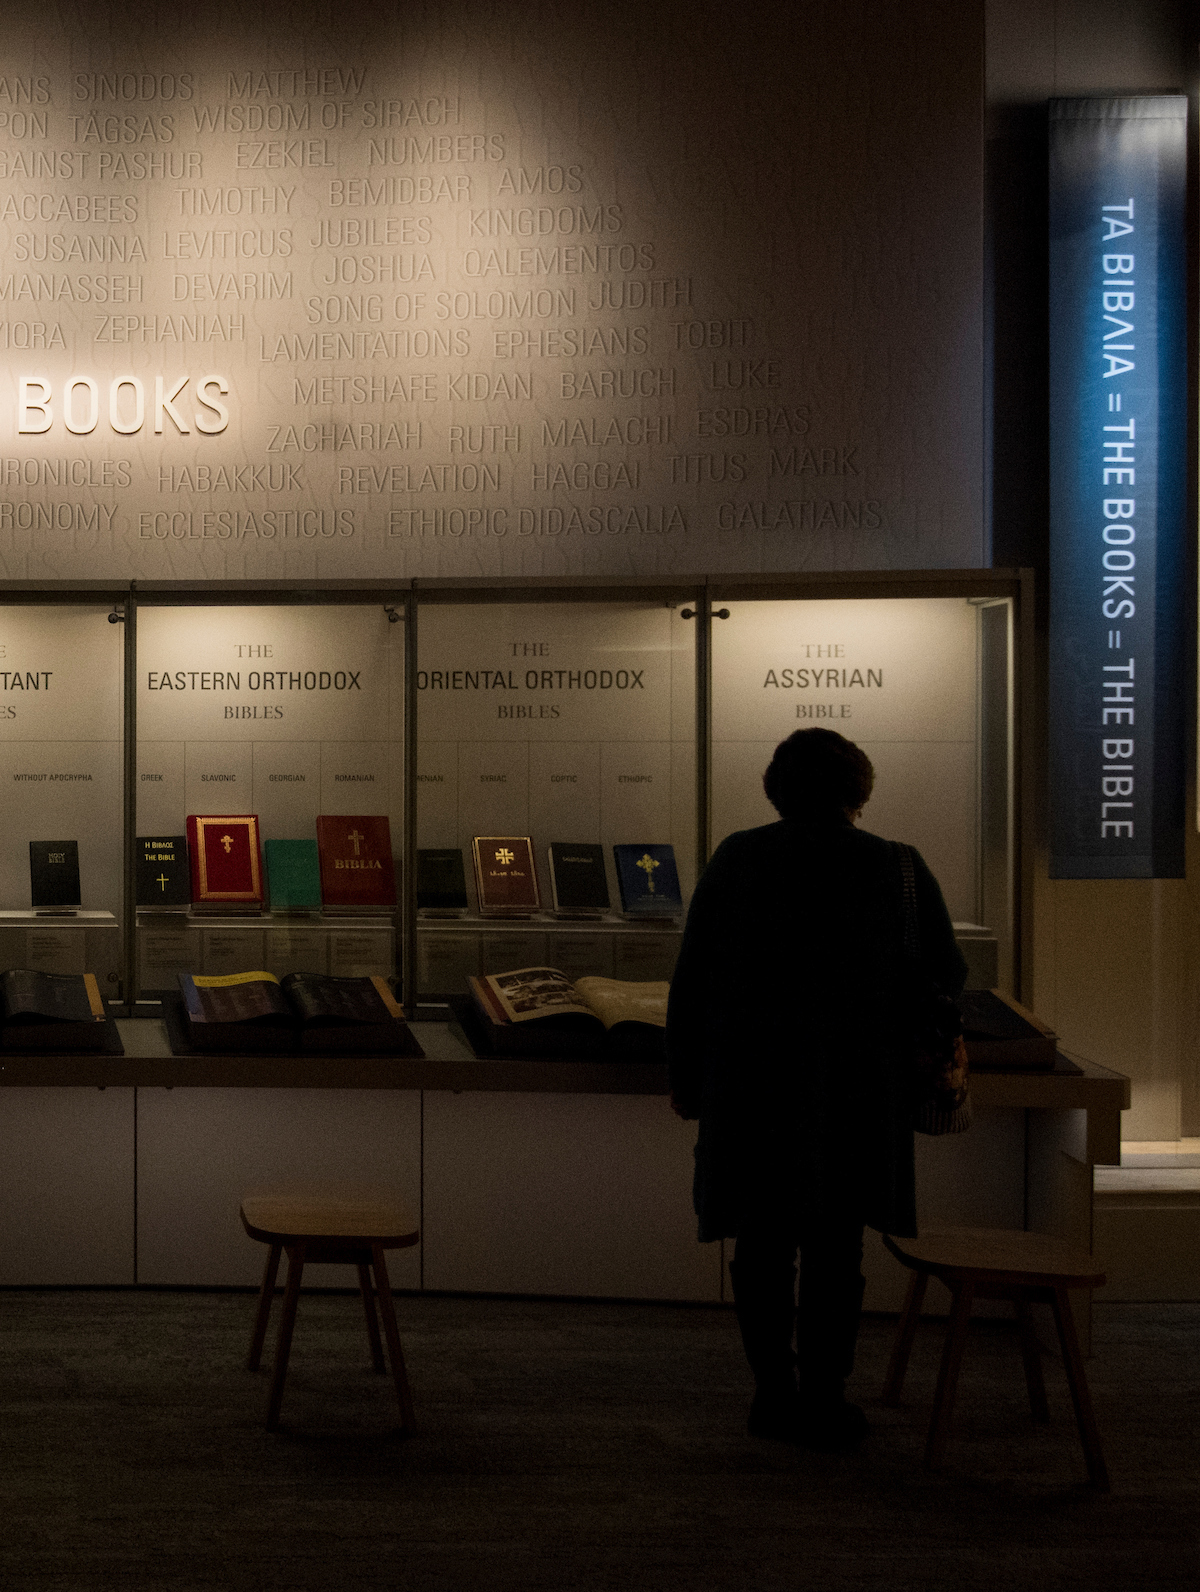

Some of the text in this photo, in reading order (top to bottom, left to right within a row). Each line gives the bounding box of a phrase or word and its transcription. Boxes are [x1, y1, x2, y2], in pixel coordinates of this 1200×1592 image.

[194, 98, 461, 135] WISDOM OF SIRACH
[236, 140, 334, 170] EZEKIEL
[368, 134, 506, 165] NUMBERS
[99, 152, 204, 180] PASHUR
[175, 186, 296, 216] TIMOTHY
[328, 176, 472, 207] BEMIDBAR
[13, 232, 147, 262] SUSANNA
[162, 229, 292, 260] LEVITICUS
[309, 217, 432, 249] JUBILEES
[323, 254, 436, 285] JOSHUA
[462, 243, 655, 278] QALEMENTOS
[172, 271, 292, 301] DEVARIM
[306, 290, 575, 323] SONG OF SOLOMON
[92, 314, 246, 343] ZEPHANIAH
[492, 328, 649, 359] EPHESIANS
[258, 331, 470, 363] LAMENTATIONS
[292, 371, 532, 406] METSHAFE KIDAN
[559, 368, 676, 399] BARUCH
[19, 373, 231, 438] BOOKS
[266, 422, 424, 454] ZACHARIAH
[449, 426, 521, 454] RUTH
[541, 416, 672, 448] MALACHI
[1101, 419, 1135, 486] THE
[158, 464, 304, 493] HABAKKUK
[339, 463, 501, 494] REVELATION
[531, 462, 641, 490] HAGGAI
[139, 509, 355, 540] ECCLESIASTICUS
[388, 506, 686, 538] ETHIOPIC DIDASCALIA
[1100, 499, 1135, 620] BOOKS
[234, 643, 273, 659] THE
[509, 642, 550, 657] THE
[801, 643, 845, 658] THE
[147, 671, 362, 691] EASTERN ORTHODOX
[417, 670, 645, 690] ORIENTAL ORTHODOX
[763, 668, 883, 689] ASSYRIAN
[1101, 658, 1135, 725] THE
[223, 705, 284, 720] BIBLES
[497, 704, 560, 719] BIBLES
[795, 704, 852, 719] BIBLE
[13, 774, 93, 782] WITHOUT APOCRYPHA
[141, 774, 163, 782] GREEK
[201, 774, 236, 782] SLAVONIC
[269, 774, 306, 782] GEORGIAN
[550, 775, 578, 783] COPTIC
[618, 775, 653, 783] ETHIOPIC
[1100, 741, 1134, 839] BIBLE
[334, 859, 383, 870] BIBLIA
